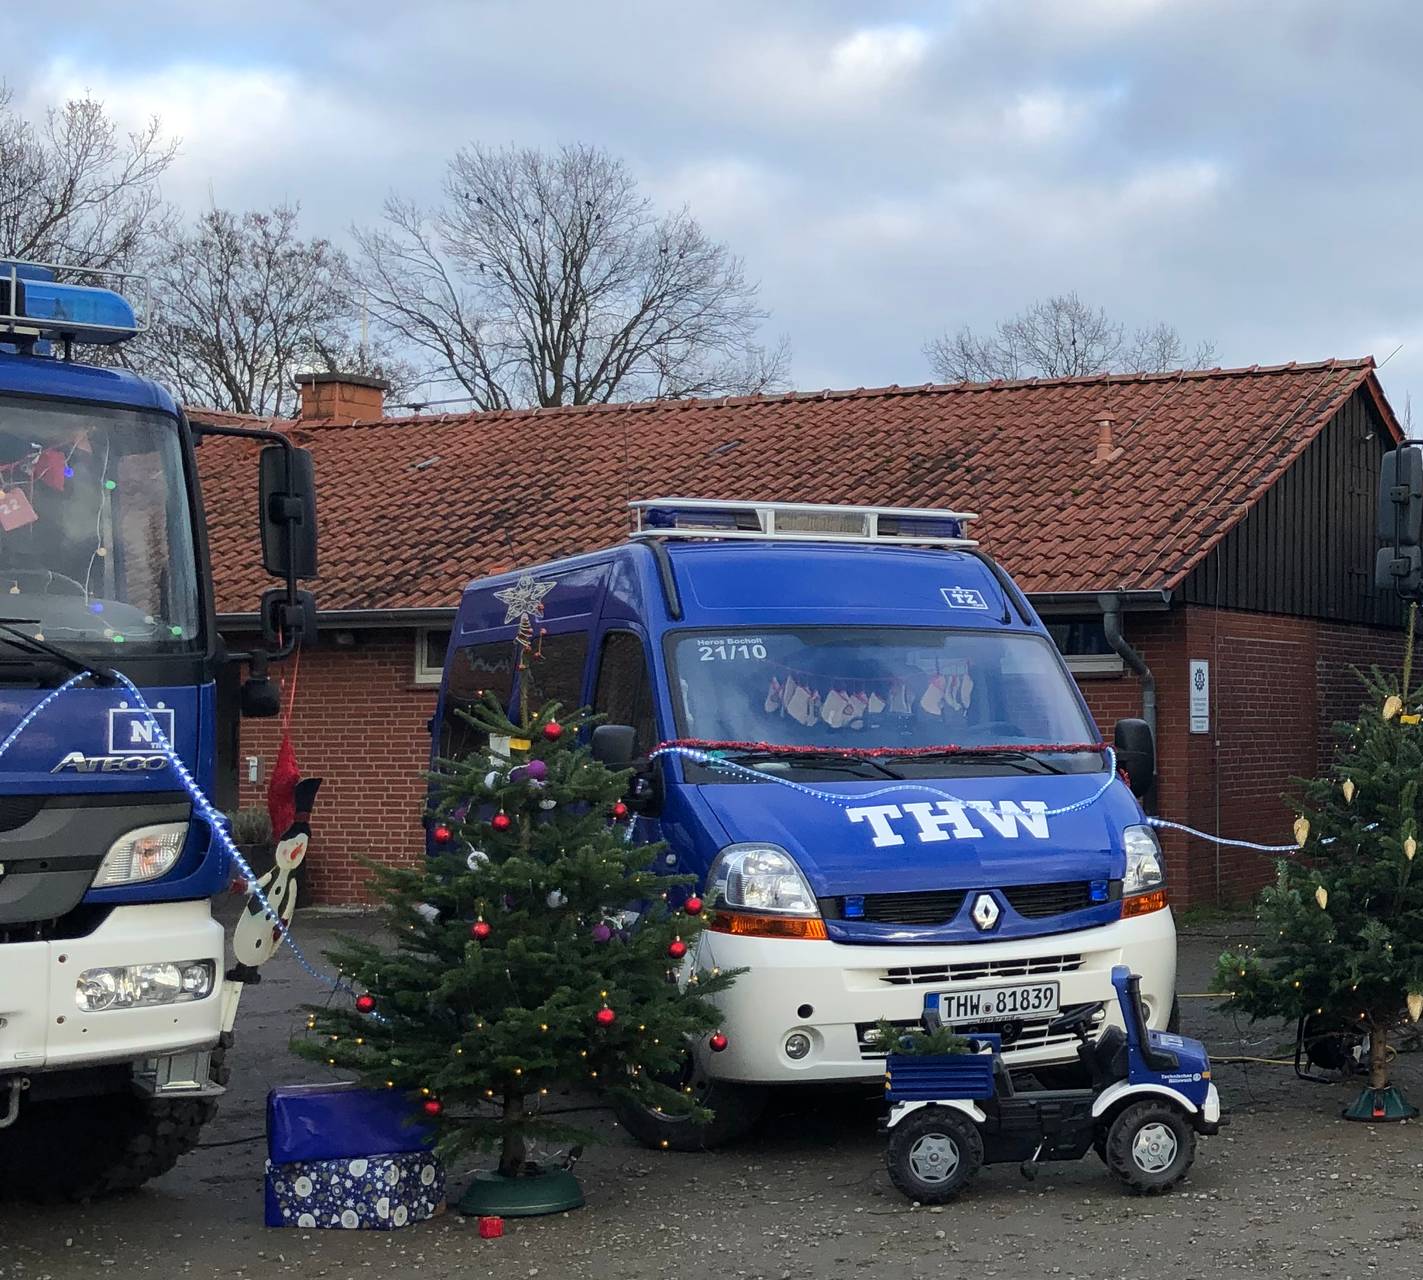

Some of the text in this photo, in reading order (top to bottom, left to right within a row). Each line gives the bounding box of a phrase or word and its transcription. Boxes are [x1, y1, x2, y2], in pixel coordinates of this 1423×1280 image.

[951, 593, 978, 604] TZ
[698, 644, 767, 661] 21/10
[130, 720, 154, 742] N
[845, 801, 1050, 847] THW
[943, 986, 1054, 1018] THW 81839
